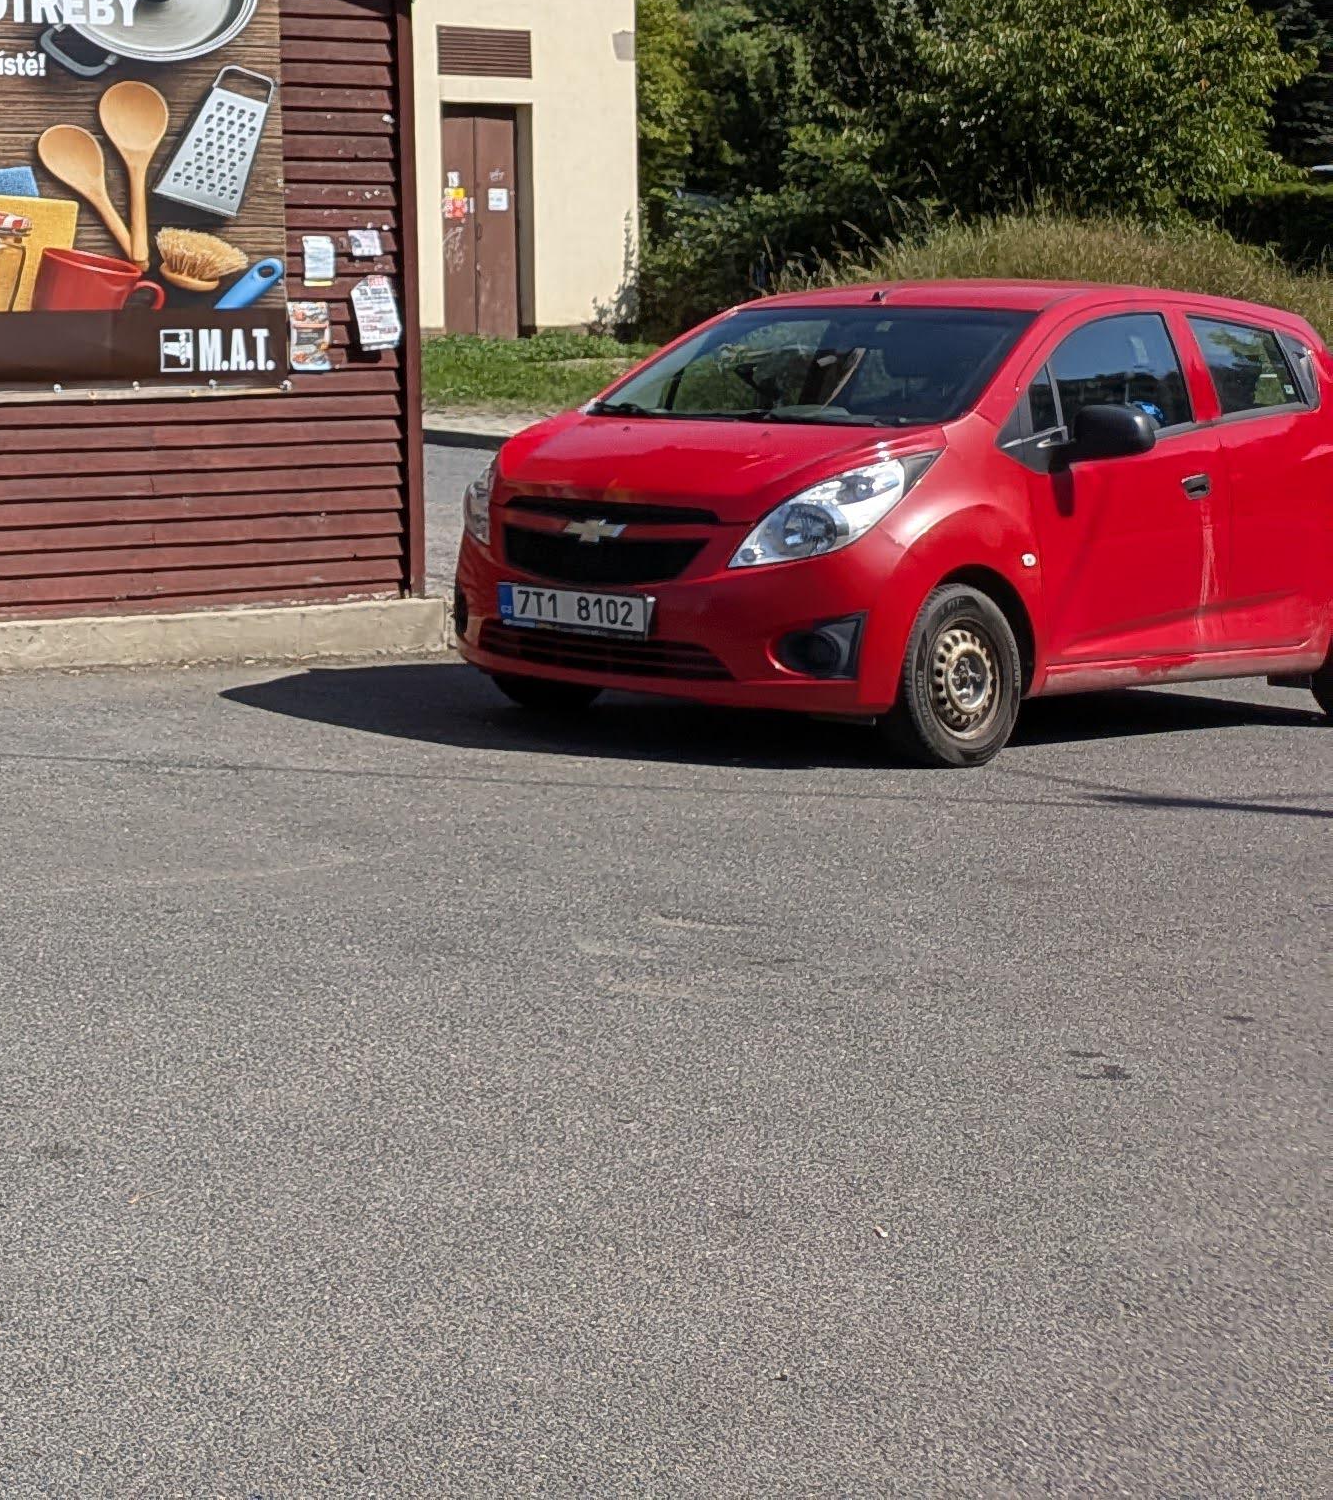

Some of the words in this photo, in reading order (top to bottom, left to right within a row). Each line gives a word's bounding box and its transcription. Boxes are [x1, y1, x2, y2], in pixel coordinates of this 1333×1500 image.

[198, 328, 276, 372] M.A.T.
[517, 589, 558, 619] 7T1
[576, 596, 633, 627] 8102
